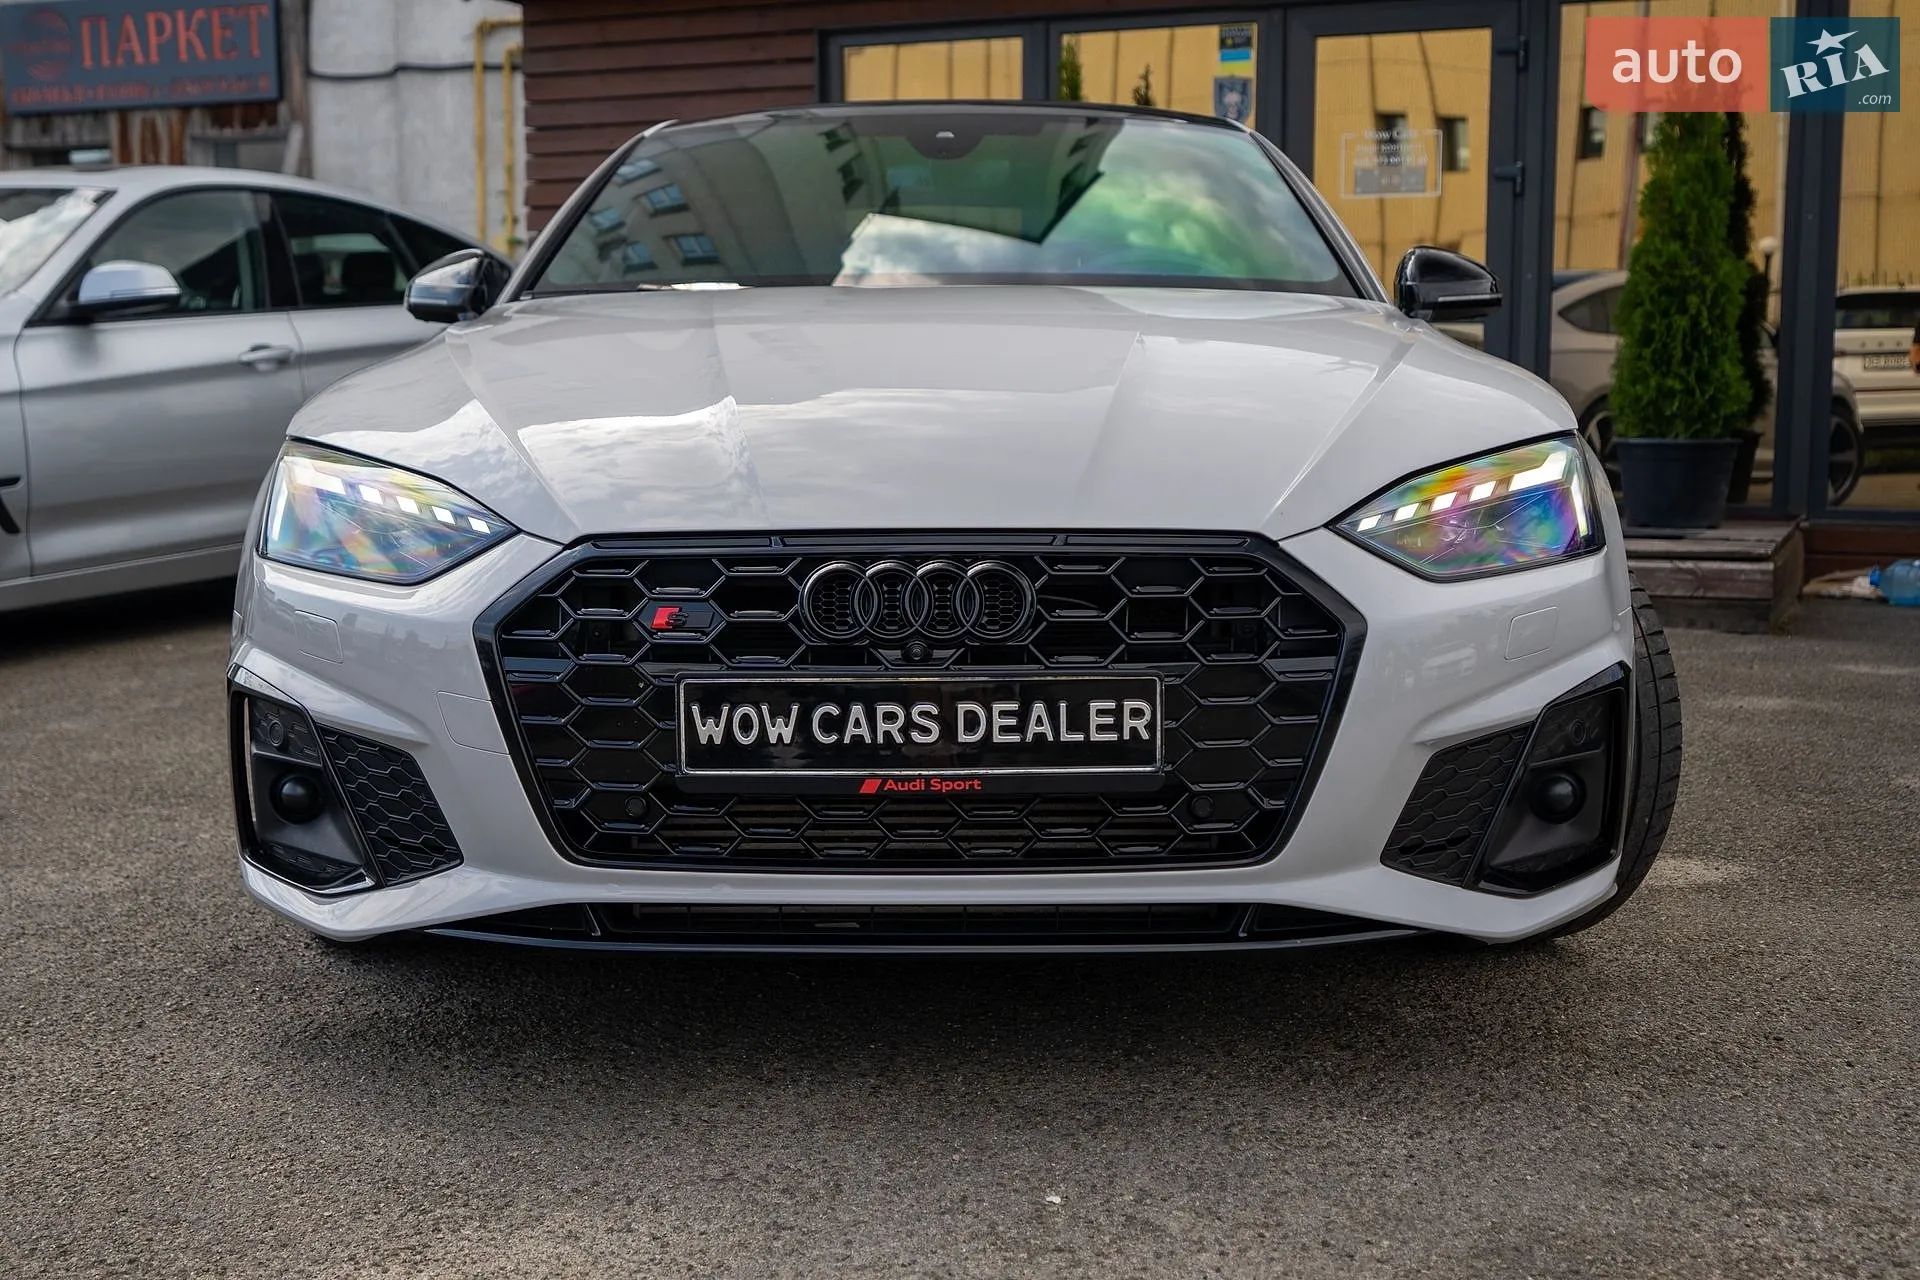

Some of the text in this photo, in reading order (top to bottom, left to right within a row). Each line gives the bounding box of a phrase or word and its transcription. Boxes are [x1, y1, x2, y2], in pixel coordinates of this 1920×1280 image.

[80, 4, 270, 69] ПАРКЕТ
[690, 701, 1152, 745] WOW CARS DEALER
[884, 778, 982, 793] Audi Sport
